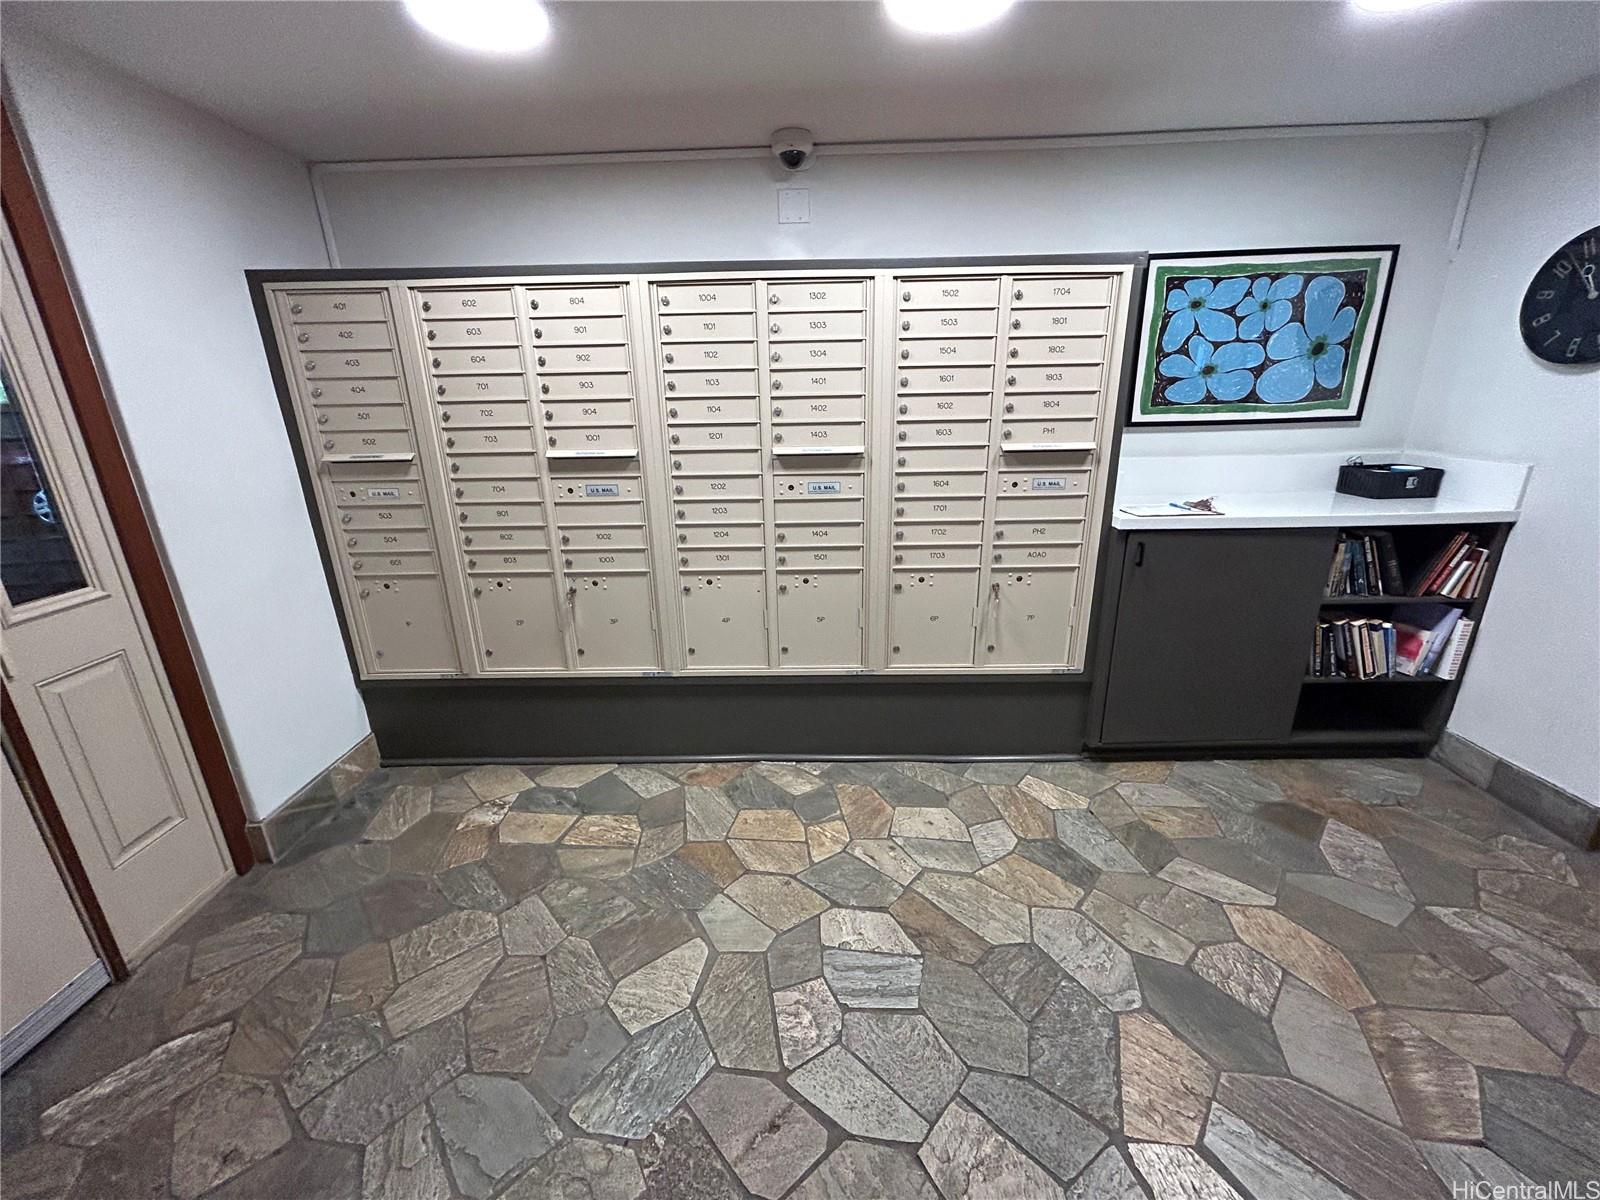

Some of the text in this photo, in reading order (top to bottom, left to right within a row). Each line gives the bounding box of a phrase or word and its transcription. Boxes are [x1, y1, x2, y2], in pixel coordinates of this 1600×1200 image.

[1552, 259, 1573, 279] 10
[809, 291, 827, 300] 1302
[941, 288, 960, 298] 1502
[1053, 287, 1071, 296] 1704
[569, 296, 585, 305] 804
[698, 293, 717, 302] 1004
[332, 302, 347, 311] 401
[461, 298, 477, 308] 602
[940, 318, 959, 327] 1503
[1051, 316, 1068, 325] 1801
[1532, 313, 1551, 327] 8
[573, 325, 588, 334] 901
[703, 322, 716, 331] 1101
[809, 321, 828, 330] 1303
[337, 330, 354, 339] 402
[465, 327, 482, 336] 603
[1543, 329, 1561, 346] 7
[809, 349, 827, 358] 1304
[939, 346, 957, 355] 1504
[1048, 345, 1066, 354] 1802
[575, 353, 591, 362] 902
[703, 350, 719, 359] 1102
[344, 358, 361, 367] 403
[470, 355, 486, 364] 604
[810, 377, 827, 385] 1401
[939, 374, 955, 383] 1601
[1045, 373, 1063, 381] 1803
[476, 382, 489, 391] 701
[578, 381, 594, 389] 903
[705, 378, 720, 387] 1103
[350, 386, 366, 394] 404
[810, 404, 828, 412] 1402
[936, 401, 954, 410] 1602
[1043, 400, 1060, 409] 1804
[479, 408, 494, 417] 702
[582, 407, 598, 416] 904
[706, 405, 722, 414] 1104
[357, 412, 371, 420] 501
[810, 430, 828, 439] 1403
[935, 428, 953, 437] 1603
[1042, 427, 1056, 435] PH1
[483, 435, 498, 443] 703
[585, 434, 601, 442] 1001
[708, 432, 723, 440] 1201
[361, 438, 377, 446] 502
[710, 482, 727, 491] 1202
[932, 480, 950, 488] 1604
[491, 485, 506, 493] 704
[711, 506, 728, 515] 1203
[933, 504, 948, 512] 1701
[378, 512, 393, 520] 503
[712, 530, 729, 538] 1204
[811, 530, 829, 538] 1404
[931, 528, 947, 536] 1702
[1032, 527, 1047, 535] PH2
[383, 536, 398, 544] 504
[595, 532, 613, 541] 1002
[598, 555, 616, 564] 1003
[715, 554, 730, 562] 1301
[813, 553, 828, 561] 1501
[929, 551, 946, 560] 1703
[721, 616, 731, 624] 4P
[1026, 614, 1036, 622] 7P
